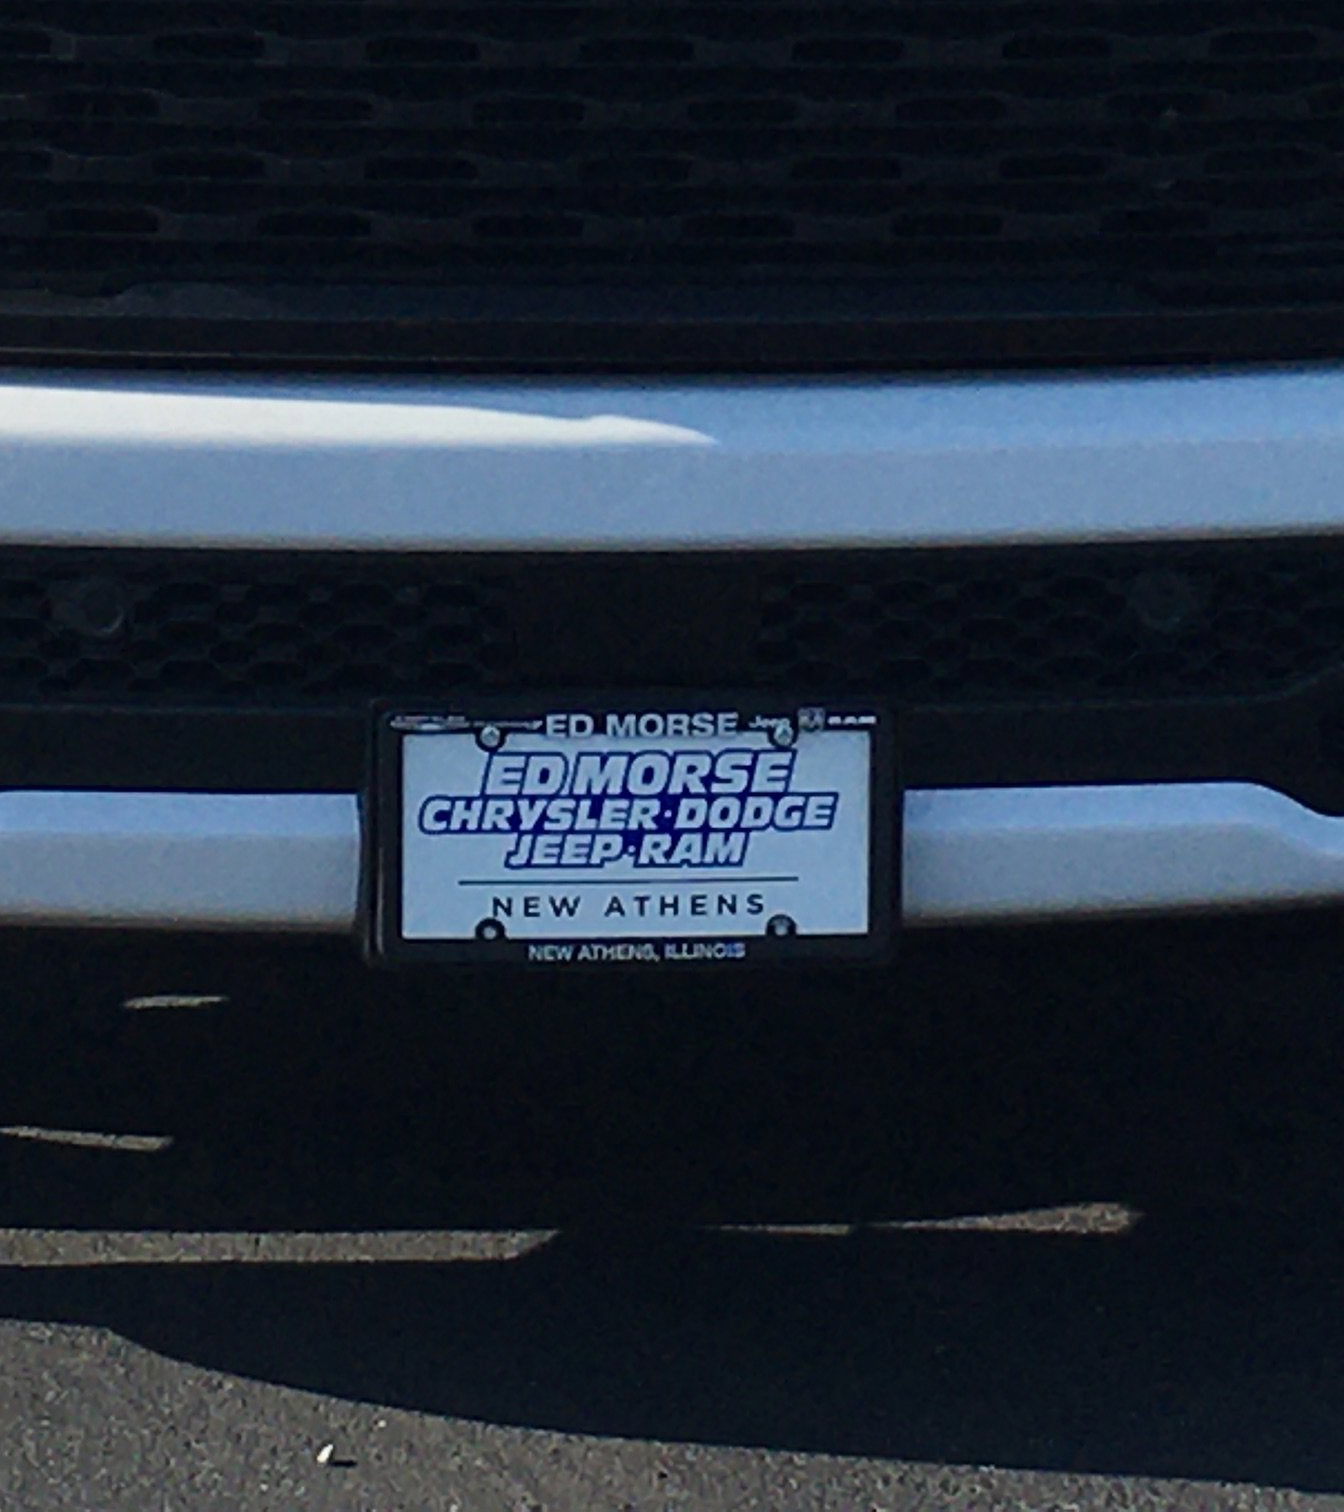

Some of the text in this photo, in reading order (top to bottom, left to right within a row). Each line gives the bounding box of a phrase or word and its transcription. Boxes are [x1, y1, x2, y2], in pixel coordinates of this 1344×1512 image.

[546, 714, 593, 738] ED
[606, 713, 739, 738] MORSE
[480, 751, 794, 797] ED MORSE
[420, 796, 838, 832] CHRYSLER DODGE
[506, 832, 747, 867] JEEP RAM
[492, 893, 765, 917] NEW ATHENS
[529, 942, 746, 961] NEW ATHENS, ILLINOIS
